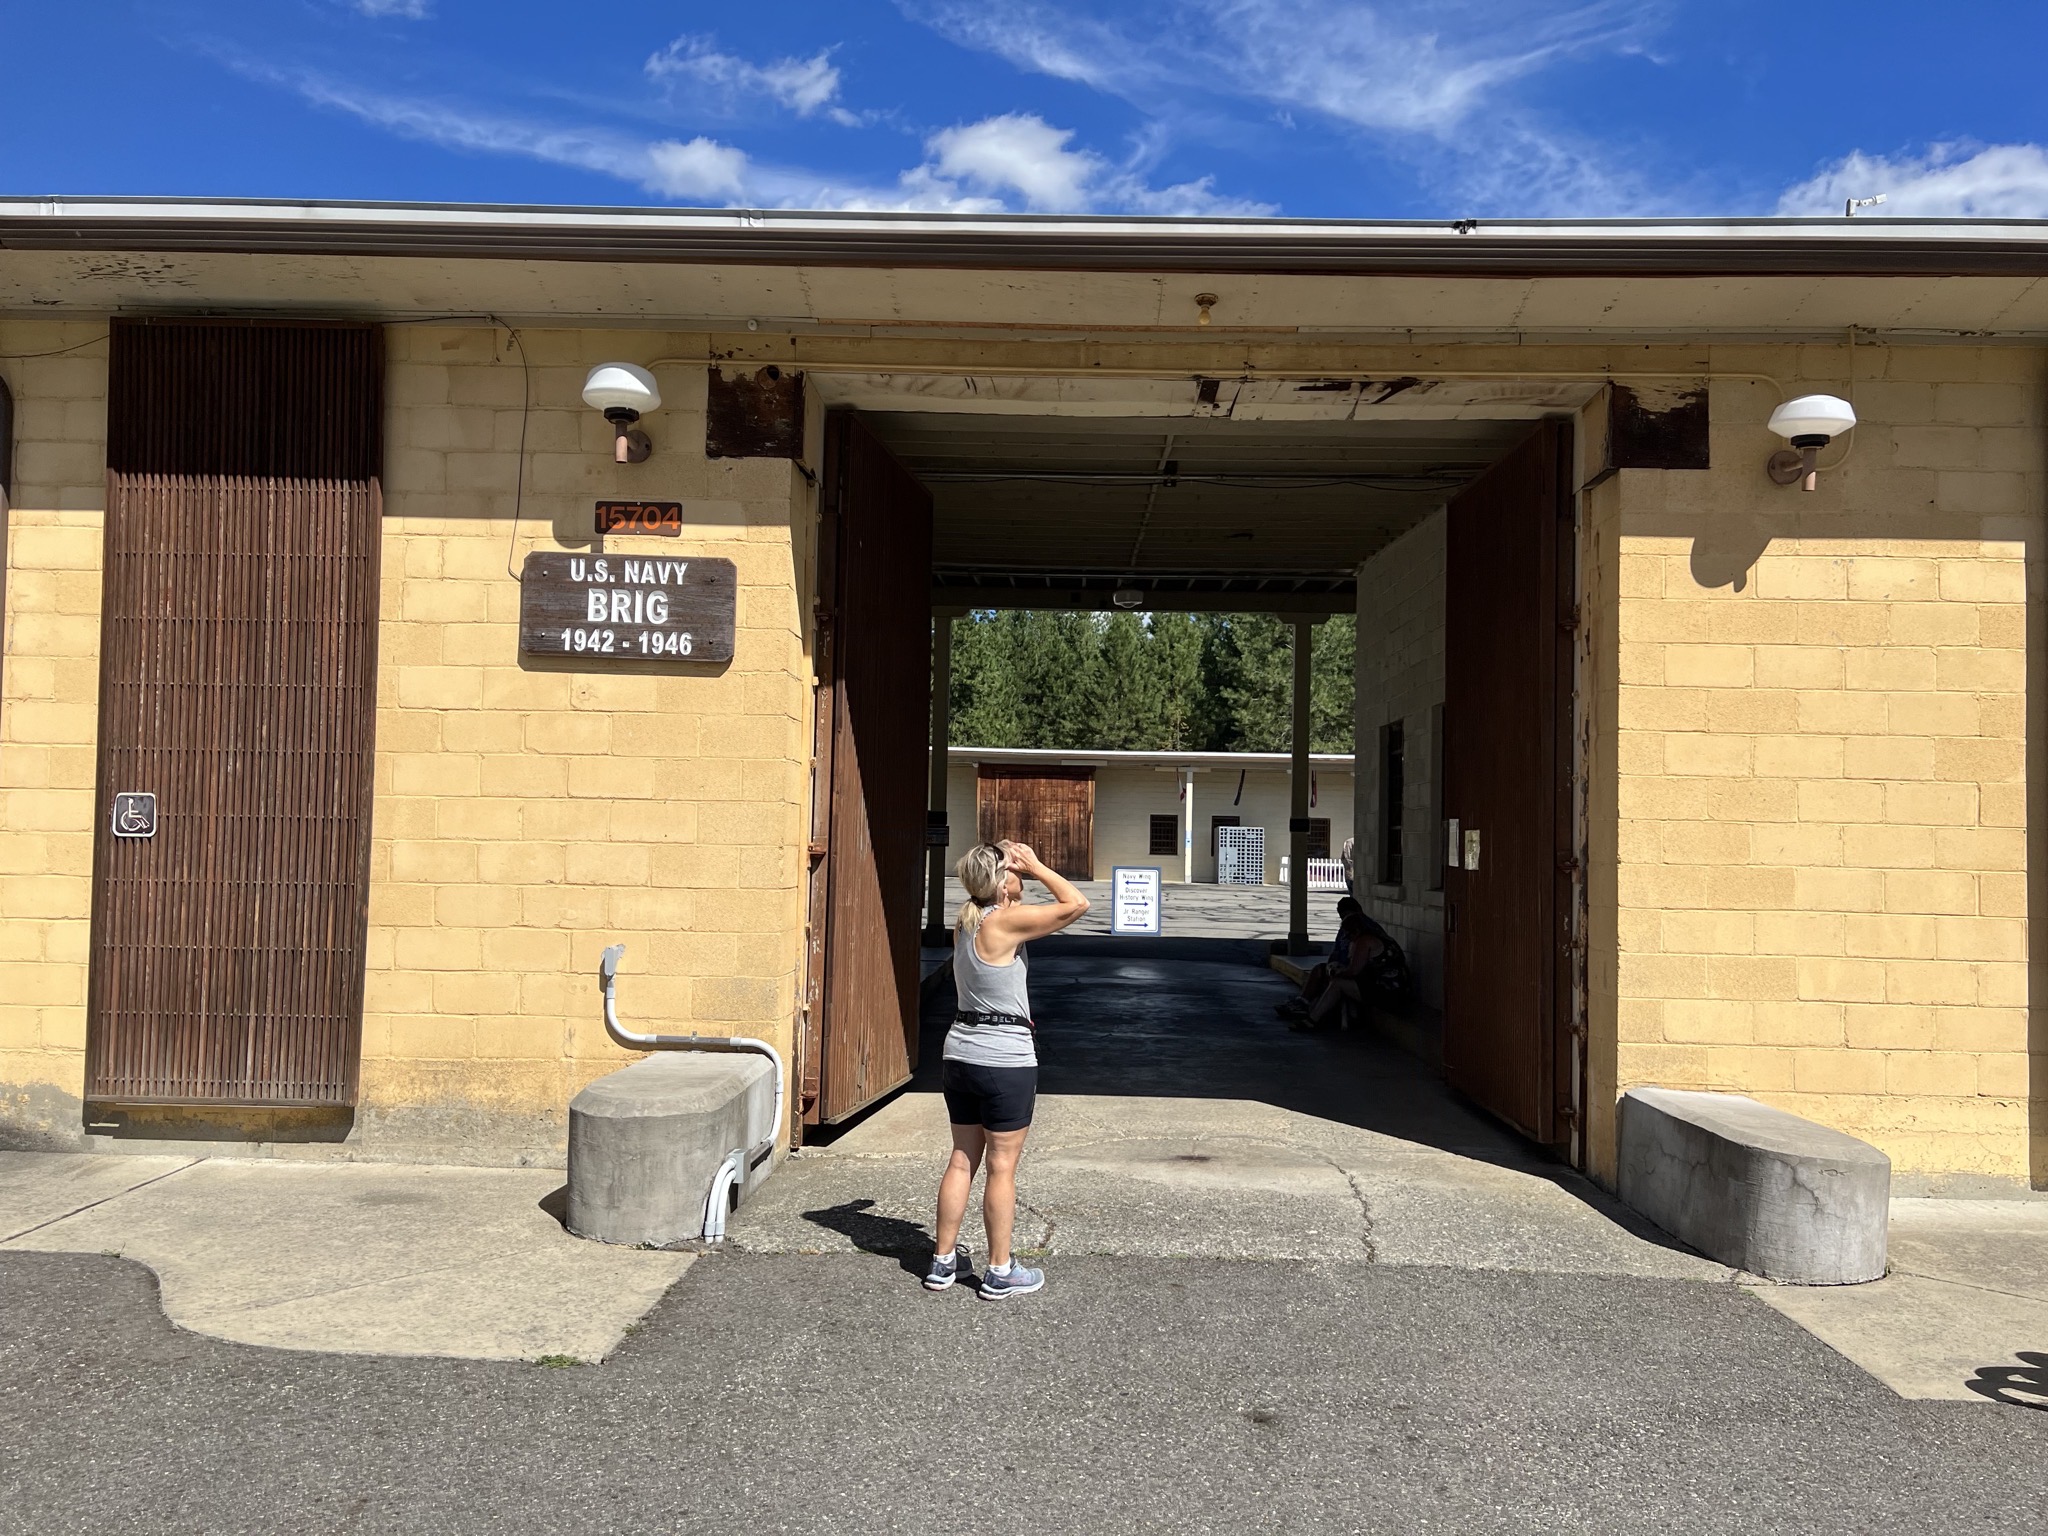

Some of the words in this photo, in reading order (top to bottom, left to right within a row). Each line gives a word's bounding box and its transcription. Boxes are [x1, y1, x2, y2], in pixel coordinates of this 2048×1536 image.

[595, 505, 681, 530] 15704
[570, 558, 615, 583] U.S.
[624, 559, 689, 585] NAVY
[587, 587, 669, 625] BRIG
[561, 628, 615, 652] 1942
[638, 630, 693, 655] 1946
